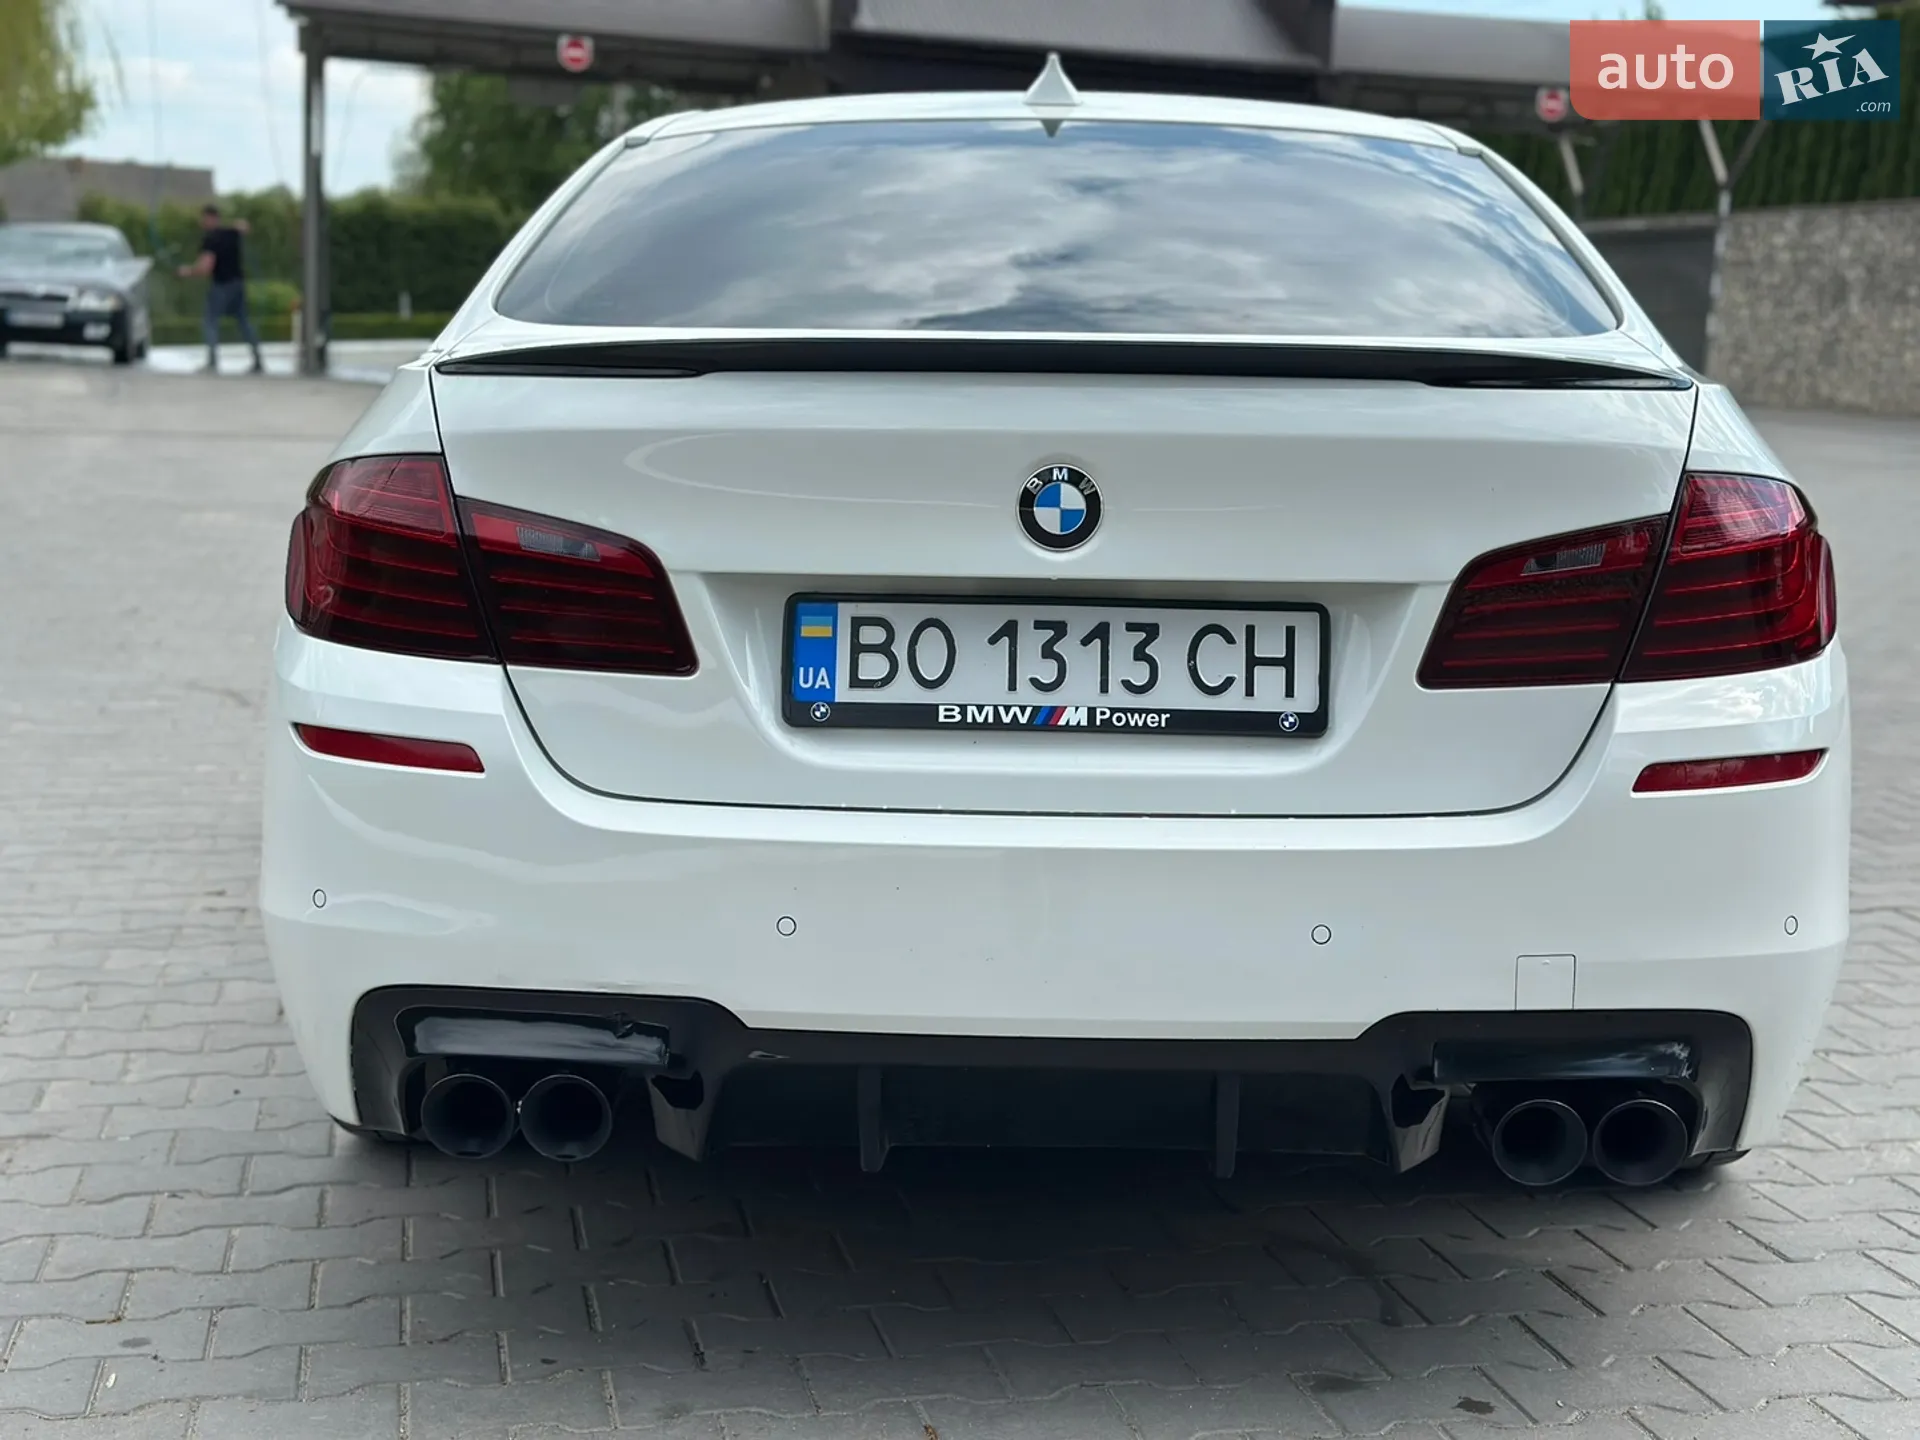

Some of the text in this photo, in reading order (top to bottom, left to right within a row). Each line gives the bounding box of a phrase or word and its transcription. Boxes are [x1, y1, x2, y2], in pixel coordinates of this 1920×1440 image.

[1026, 467, 1096, 495] BMW
[849, 616, 1296, 698] BO 1313 CH
[799, 667, 831, 689] UA
[937, 705, 1034, 724] BMW
[1096, 707, 1171, 728] Power
